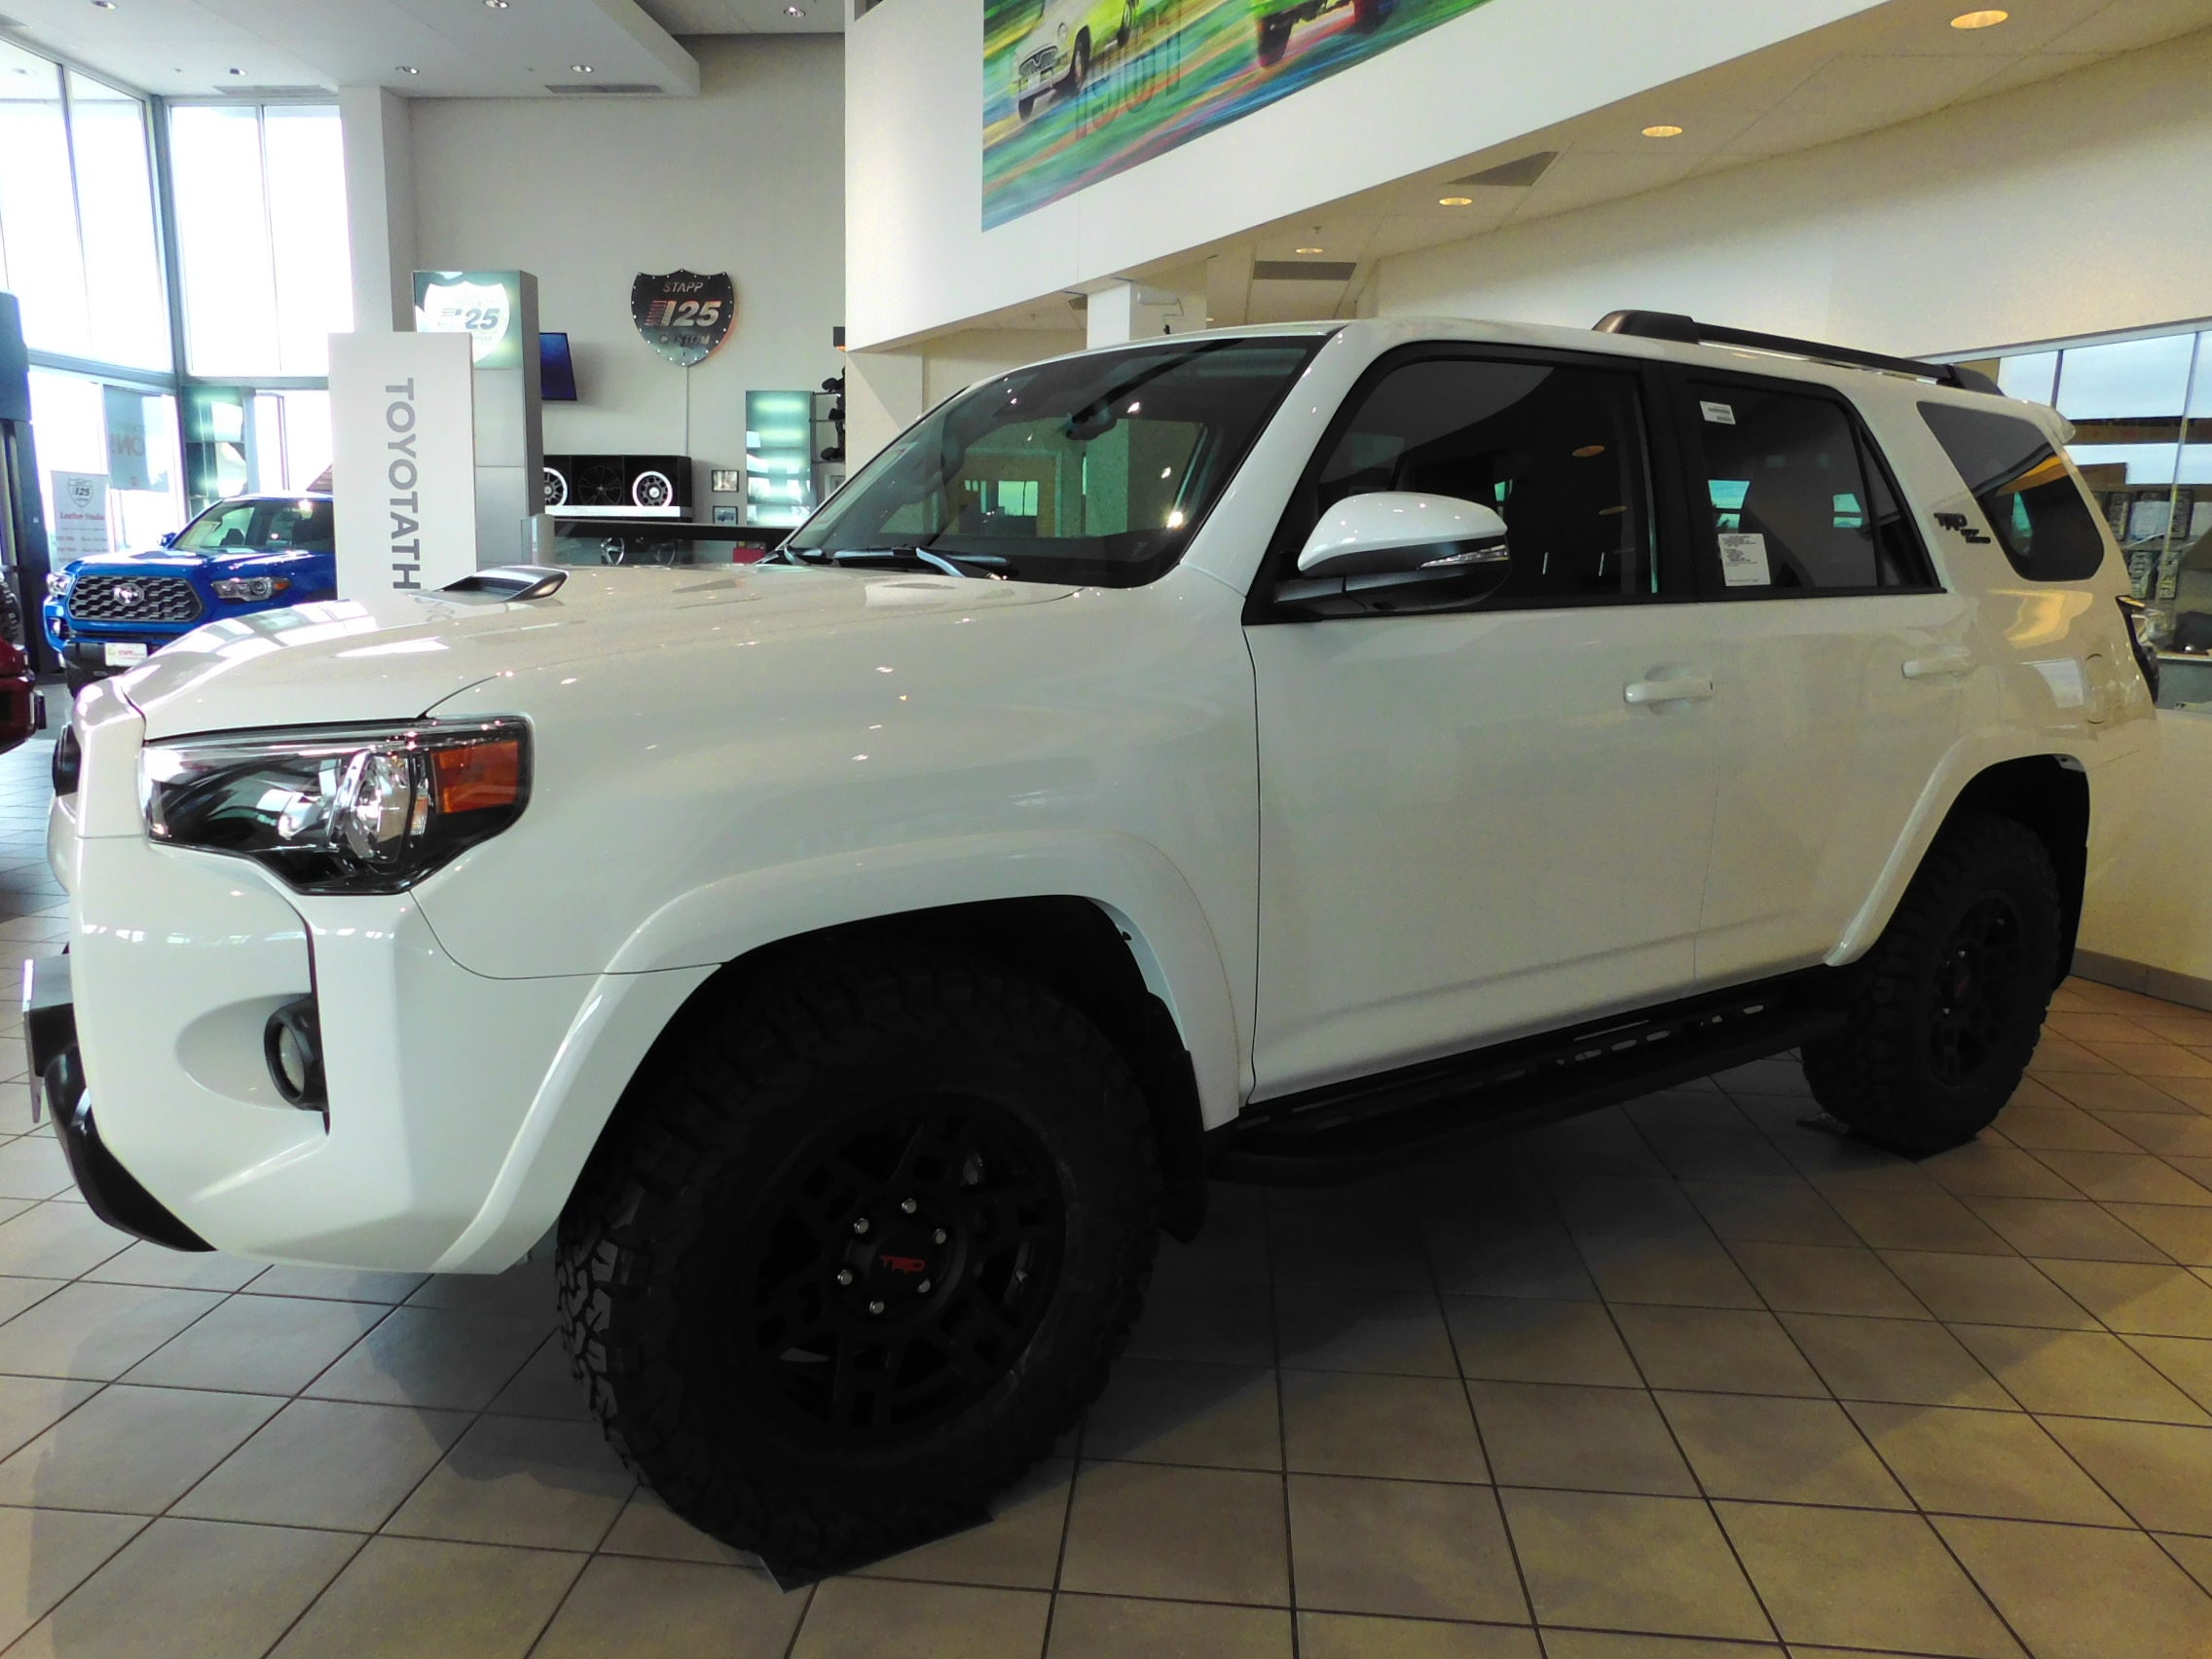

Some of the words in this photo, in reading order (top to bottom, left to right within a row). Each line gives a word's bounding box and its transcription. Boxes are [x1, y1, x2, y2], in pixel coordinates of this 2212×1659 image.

[663, 281, 704, 293] STAPP
[660, 334, 711, 346] STOM
[880, 1254, 926, 1273] TRD
